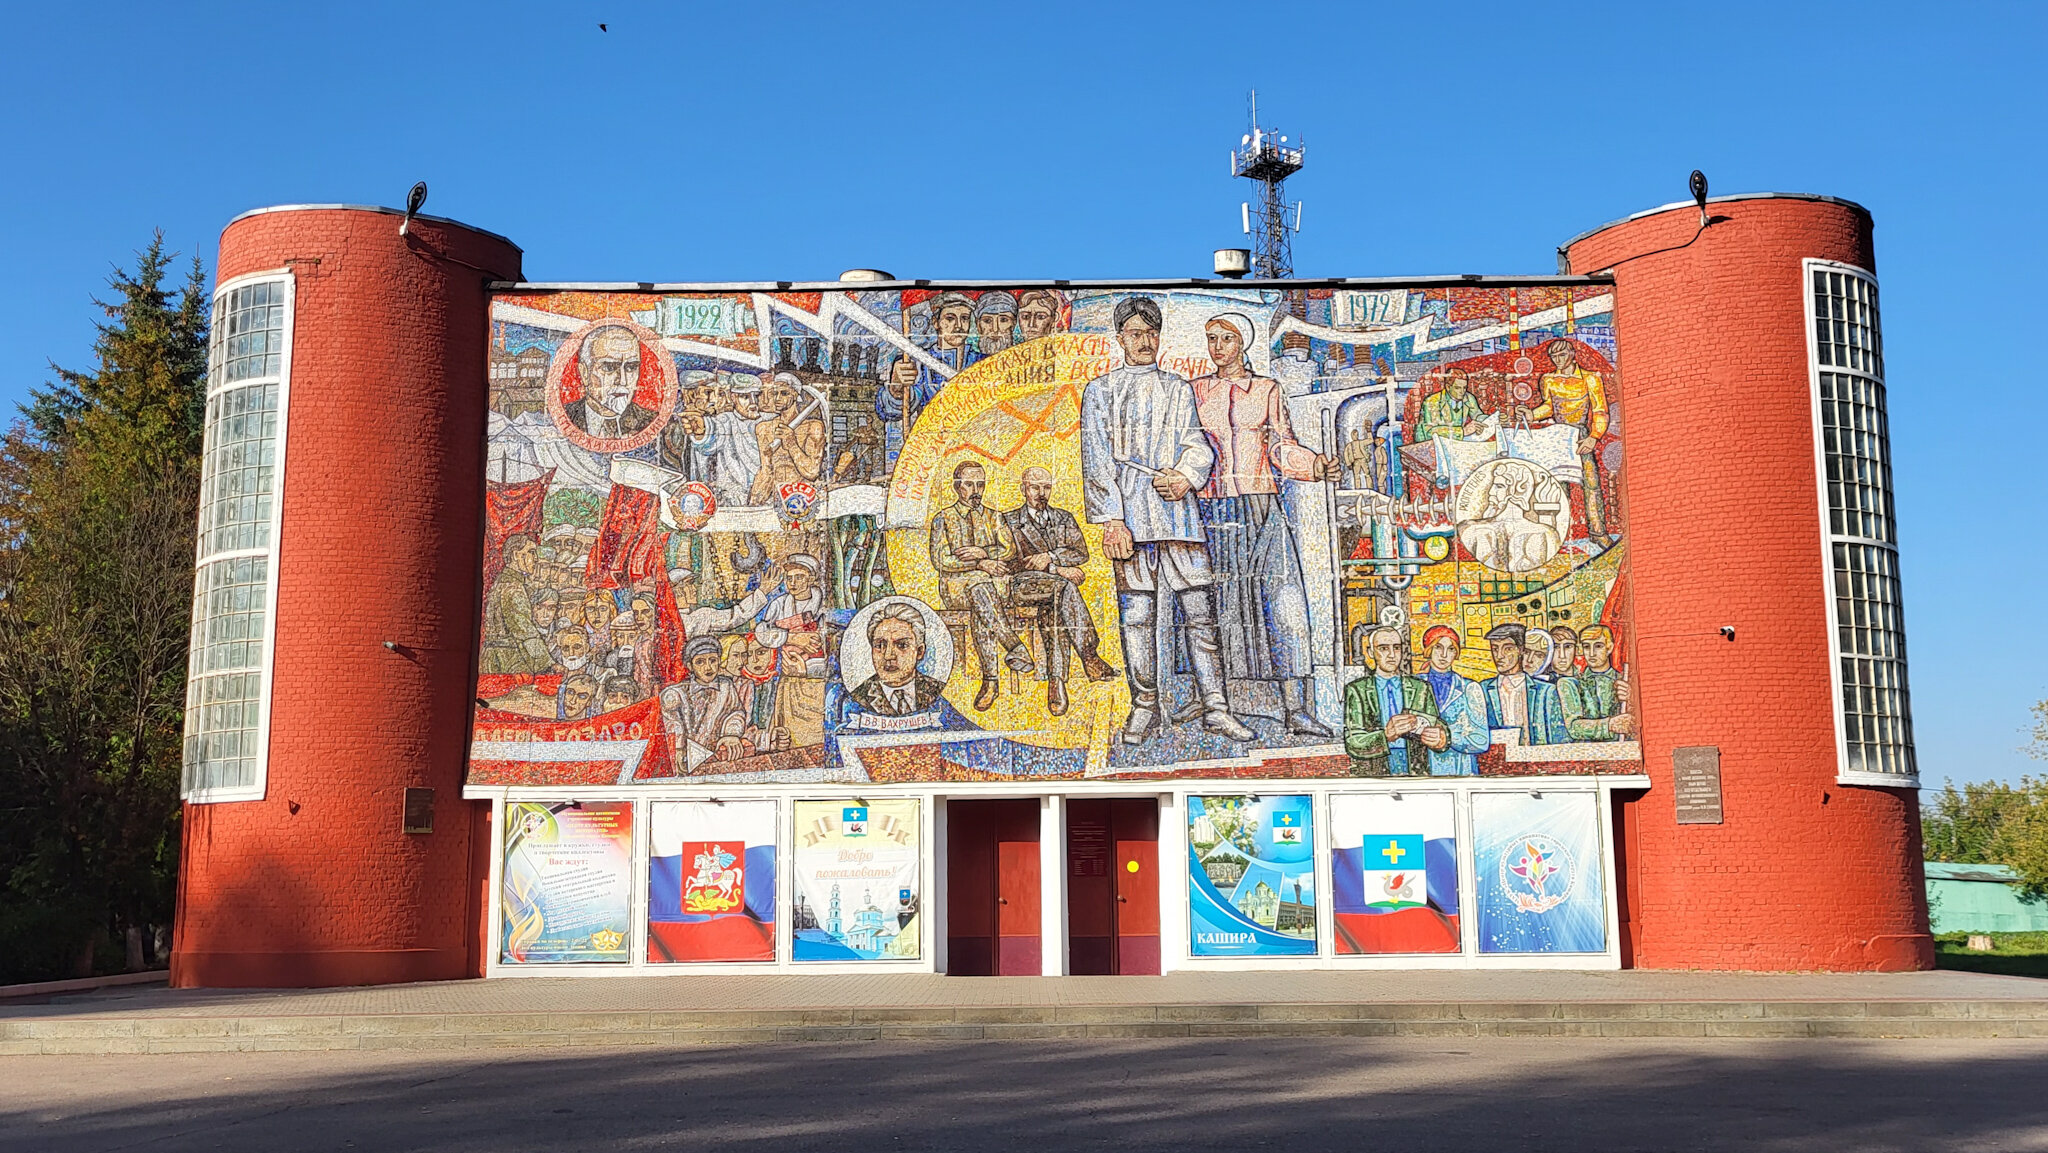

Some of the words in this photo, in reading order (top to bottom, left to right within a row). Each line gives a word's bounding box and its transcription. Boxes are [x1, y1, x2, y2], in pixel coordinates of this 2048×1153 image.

[1347, 294, 1392, 322] 1972
[675, 304, 721, 330] 1922
[955, 346, 1032, 392] СОВЕТСКАЯ
[1042, 334, 1111, 360] ВЛАСТЬ
[784, 482, 813, 495] СССР
[881, 716, 928, 729] ВАХРУШЕВ
[838, 849, 874, 865] Добро
[815, 865, 897, 878] пожаловать!
[1197, 932, 1257, 944] КАШИРА
